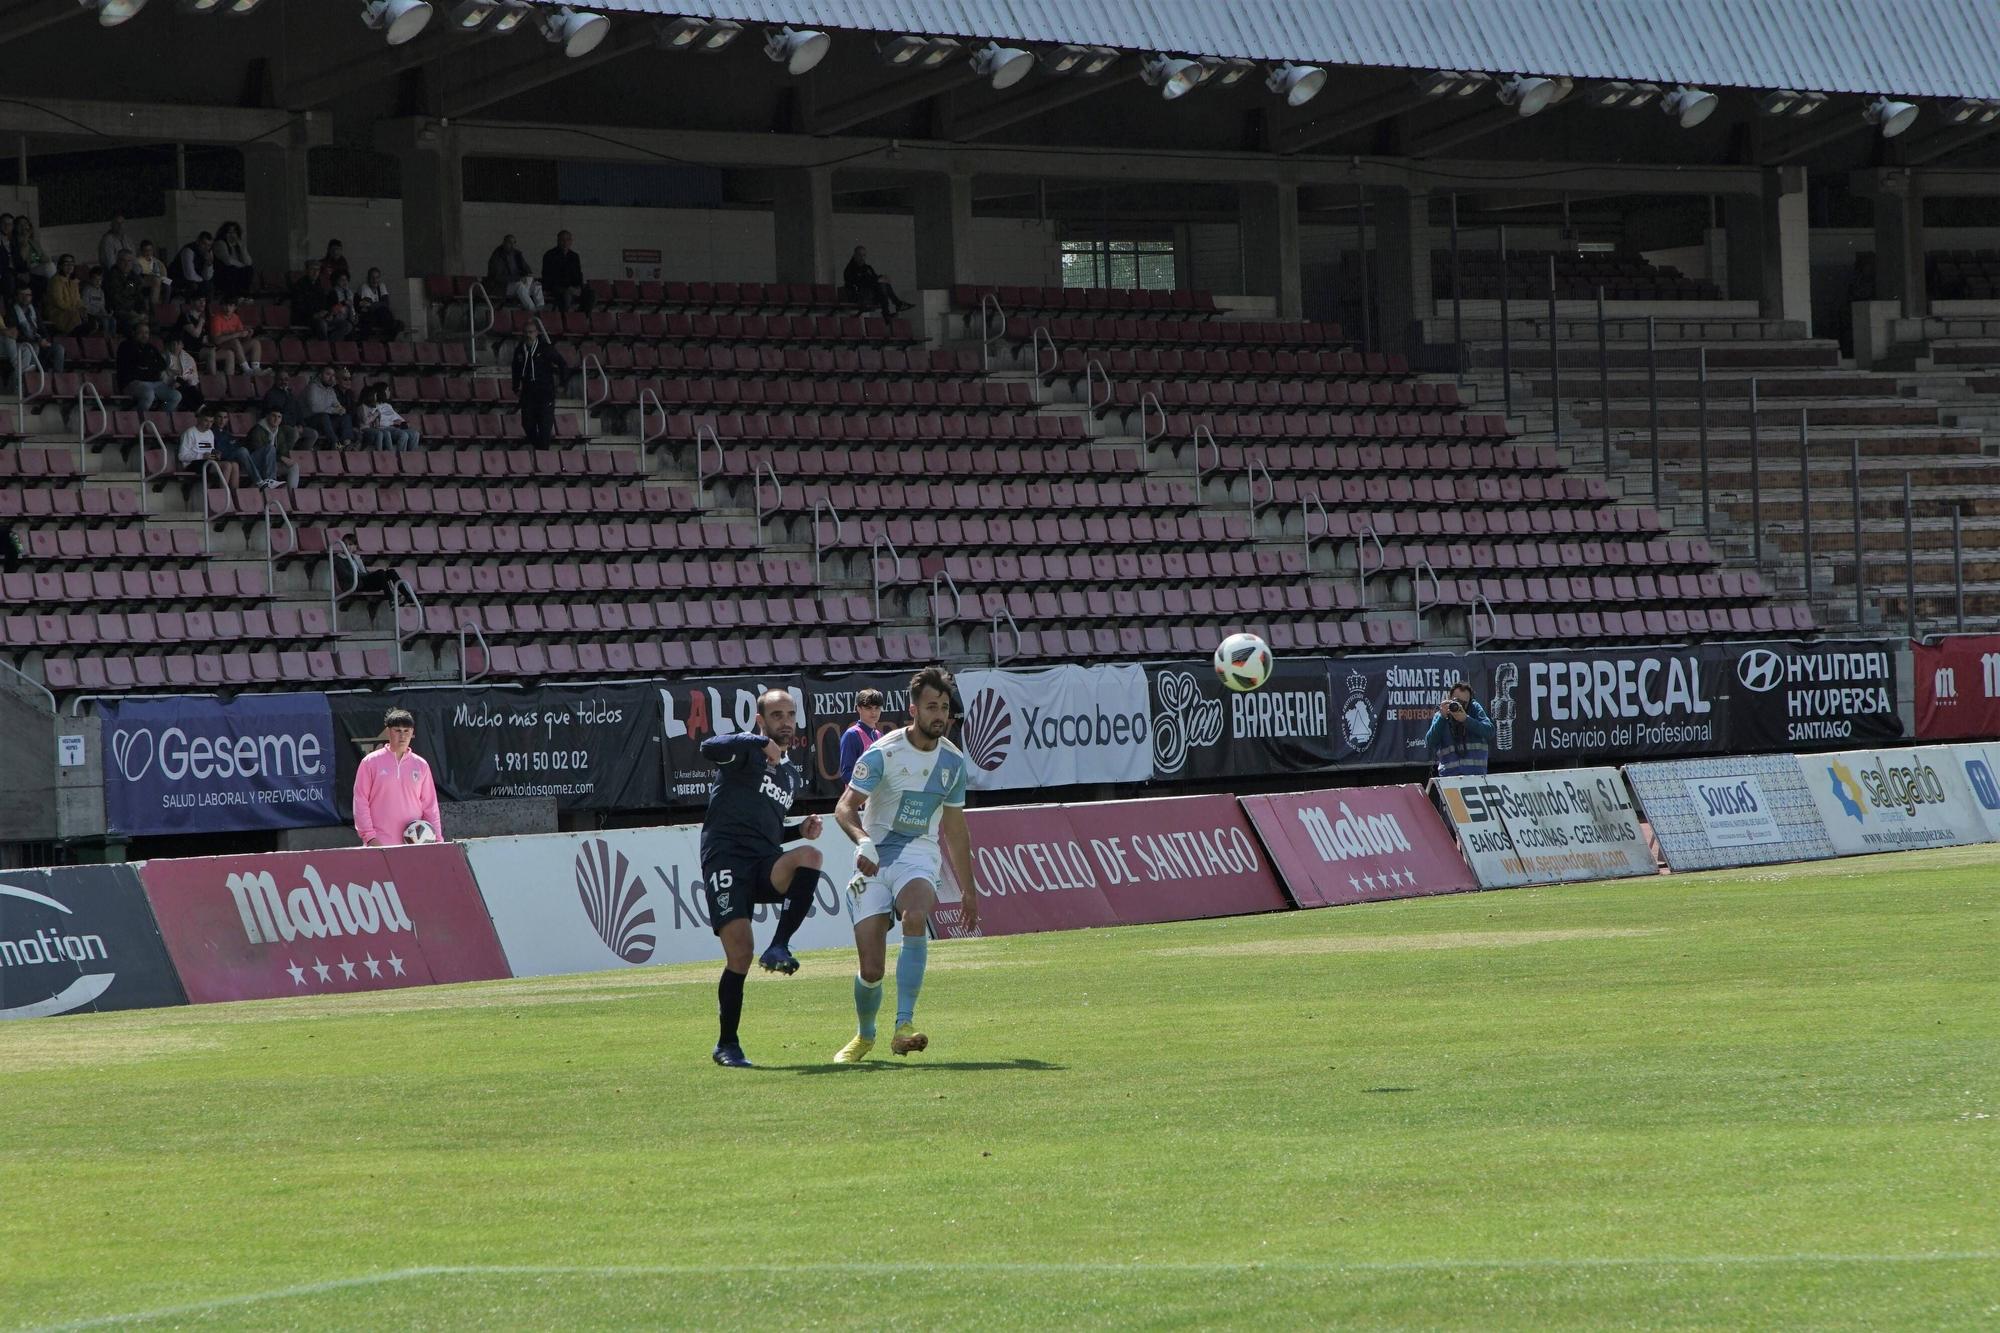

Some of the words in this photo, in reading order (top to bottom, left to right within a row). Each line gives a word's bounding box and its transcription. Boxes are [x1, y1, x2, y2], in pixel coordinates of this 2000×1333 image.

[1386, 665, 1440, 688] SÚMATE
[1787, 652, 1889, 682] HYUNDAI
[1529, 656, 1711, 721] FERRECAL
[1788, 687, 1891, 717] HYUPERSA
[453, 702, 502, 728] Mucho
[509, 712, 538, 728] más
[544, 711, 570, 740] que
[577, 699, 623, 725] toldos
[1020, 703, 1147, 750] Xacobeo
[1231, 691, 1328, 738] BARBERIA
[1387, 709, 1397, 720] DE
[1532, 728, 1546, 750] Al
[1550, 725, 1606, 749] Servicio
[1611, 723, 1631, 746] del
[1636, 720, 1712, 745] Profesional
[1788, 720, 1851, 741] SANTIAGO
[506, 752, 528, 772] 981
[533, 751, 549, 770] 50
[552, 750, 569, 770] 02
[571, 750, 588, 769] 02
[163, 792, 196, 808] SALUD
[198, 791, 247, 807] LABORAL
[249, 791, 256, 804] Y
[258, 786, 323, 805] PREVENCIÓN
[1698, 780, 1758, 817] SOUSAS
[1860, 754, 1945, 817] salgado
[902, 805, 921, 816] San
[1501, 781, 1570, 826] Segundo
[899, 813, 928, 826] Rafael
[1298, 801, 1413, 863] Mahou
[1468, 829, 1513, 853] BAÑOS
[1519, 827, 1569, 848] COCINAS
[1090, 837, 1140, 885] DE
[1132, 826, 1259, 882] SANTIAGO
[709, 869, 733, 892] 15
[225, 864, 412, 945] Mahou
